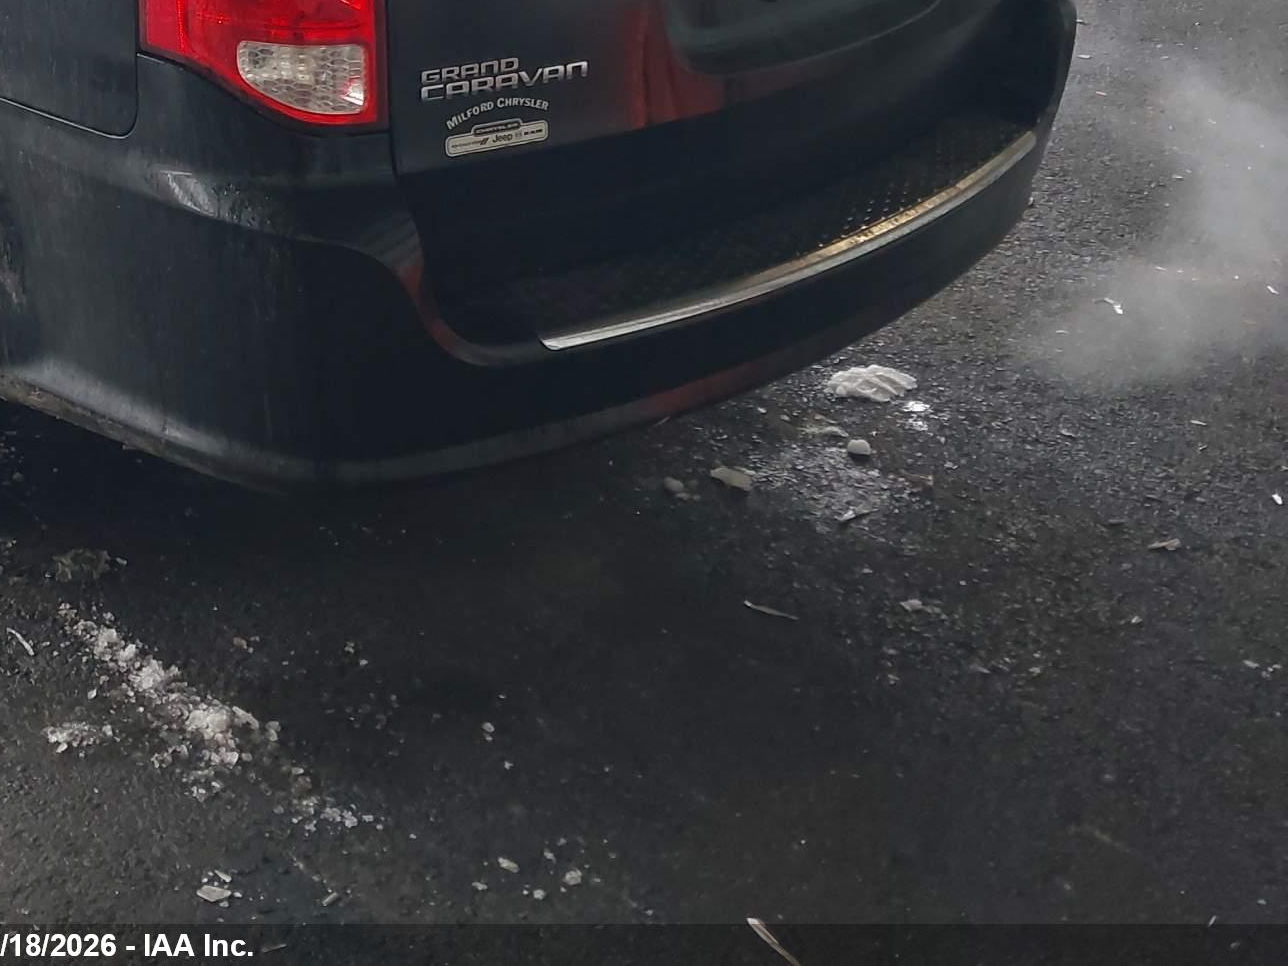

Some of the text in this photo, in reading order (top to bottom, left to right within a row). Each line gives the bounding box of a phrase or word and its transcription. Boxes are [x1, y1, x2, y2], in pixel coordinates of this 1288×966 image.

[420, 61, 588, 101] CARAVAN
[421, 57, 519, 85] GRAND
[446, 101, 494, 130] MILFORD
[497, 97, 549, 111] CHRYSLER
